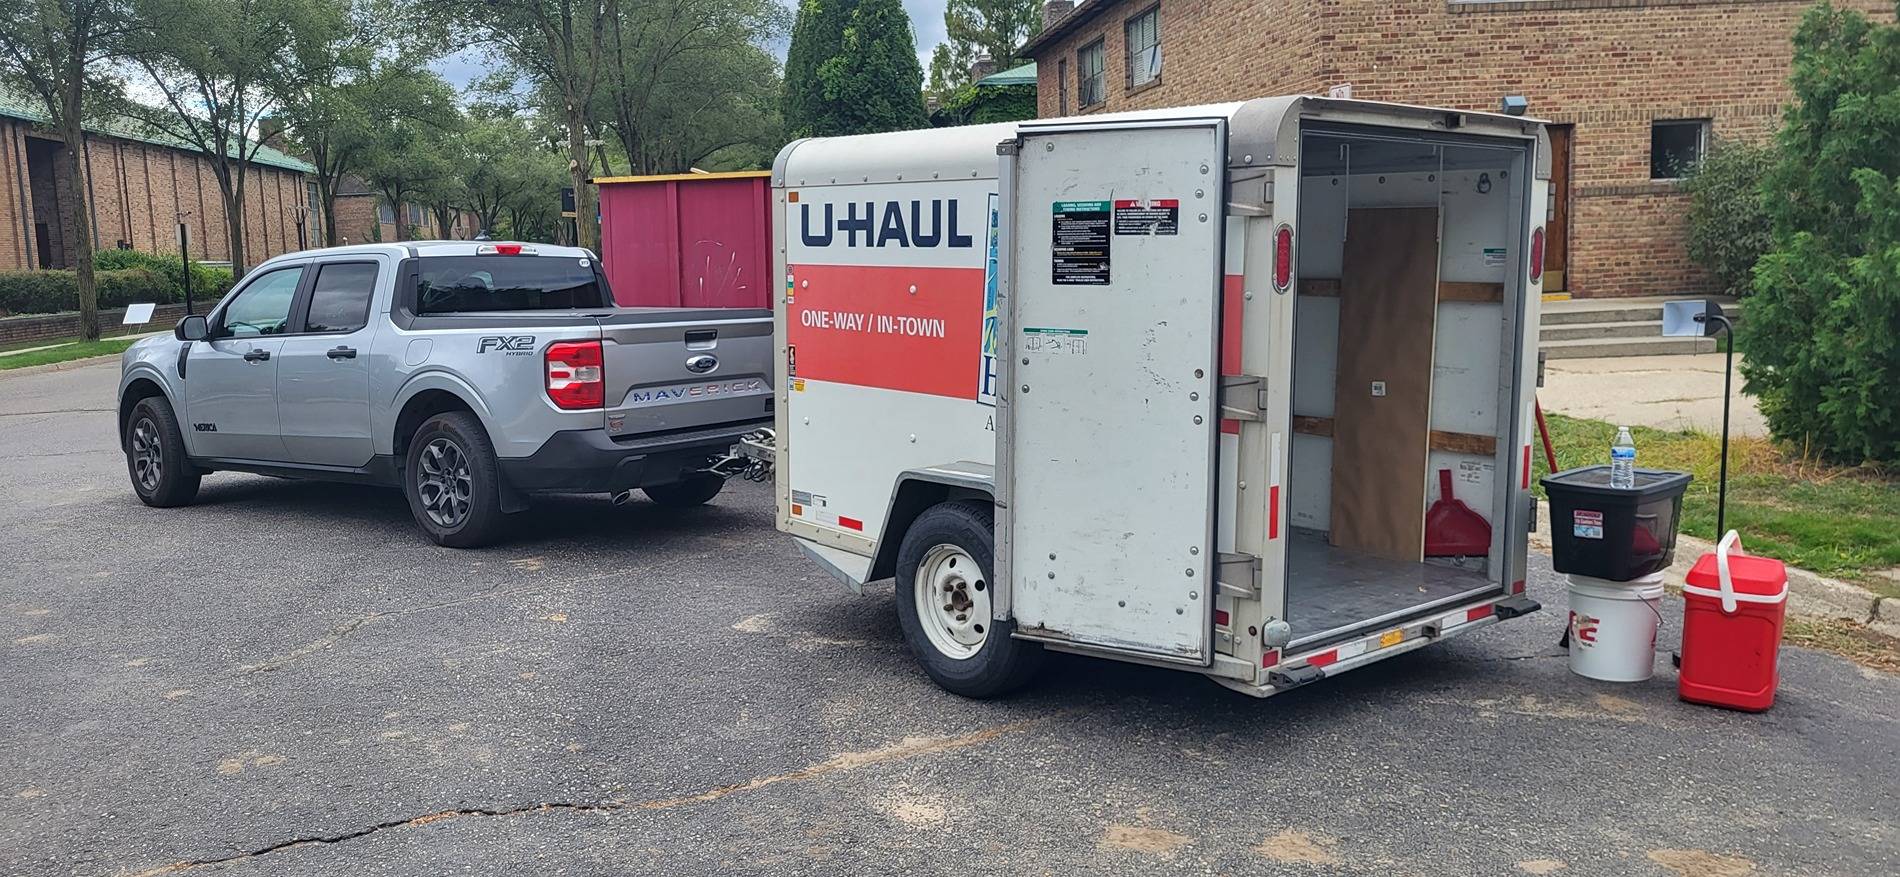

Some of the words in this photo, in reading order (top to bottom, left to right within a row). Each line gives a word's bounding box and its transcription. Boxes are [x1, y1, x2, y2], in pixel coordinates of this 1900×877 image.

[801, 198, 973, 248] U-HAUL
[801, 309, 864, 331] ONE-WAY
[877, 316, 945, 338] IN-TOWN
[476, 335, 536, 354] FX2
[633, 380, 761, 403] MAVERICK
